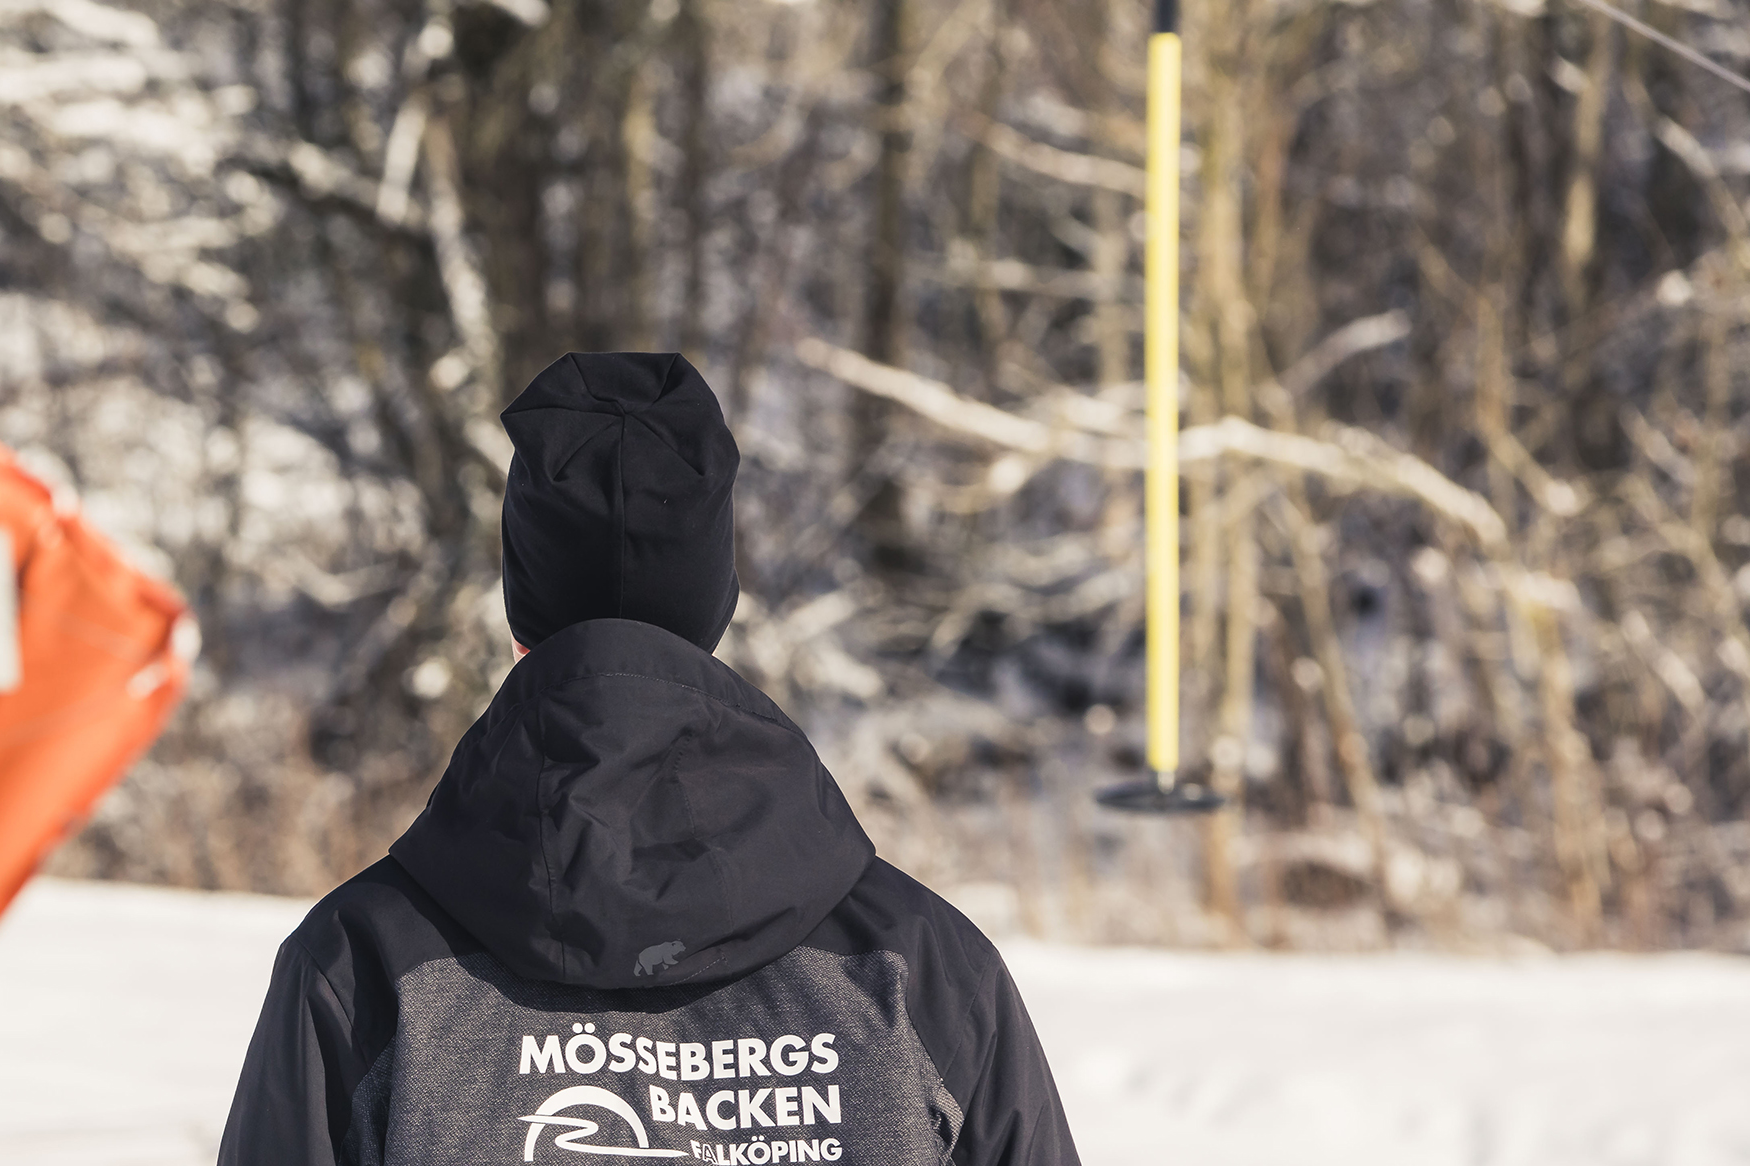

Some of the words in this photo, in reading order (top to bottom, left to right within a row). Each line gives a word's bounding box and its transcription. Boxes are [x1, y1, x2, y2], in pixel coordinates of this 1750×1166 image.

[518, 1022, 839, 1081] MÖSSEBERGS
[649, 1084, 842, 1131] BACKEN
[690, 1134, 843, 1166] FALKÖPING
